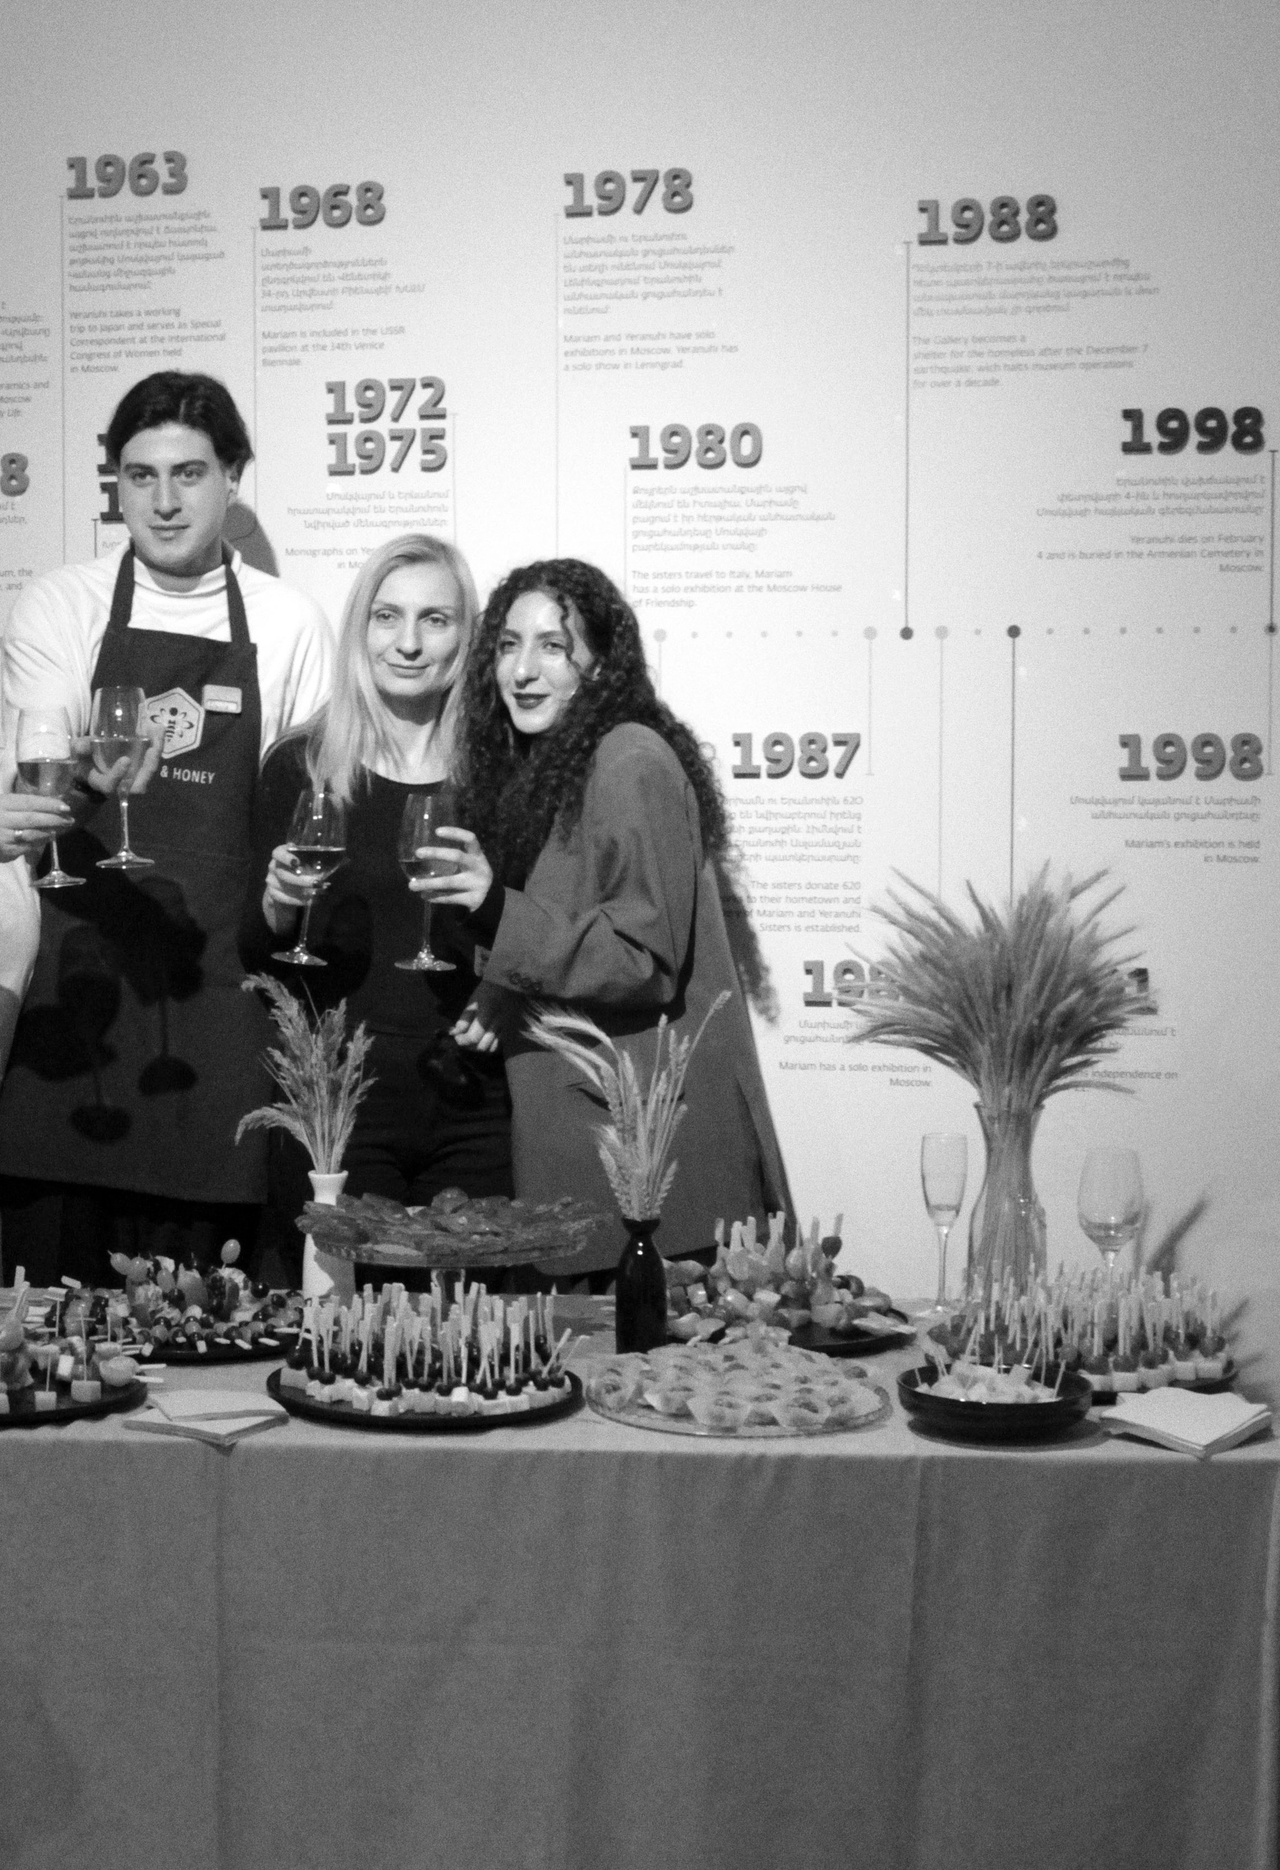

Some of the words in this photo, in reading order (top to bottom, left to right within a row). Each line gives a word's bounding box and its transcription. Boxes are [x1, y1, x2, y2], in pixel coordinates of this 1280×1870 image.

[66, 150, 188, 200] 1963
[563, 167, 694, 218] 1978
[259, 181, 386, 231] 1968
[917, 194, 1058, 246] 1988
[168, 333, 226, 342] International
[125, 350, 159, 358] Women
[325, 376, 447, 425] 1972
[1121, 406, 1265, 455] 1998
[629, 422, 763, 471] 1980
[327, 428, 448, 476] 1975
[1201, 536, 1214, 544] on
[286, 548, 343, 557] Monographs
[1126, 551, 1144, 559] the
[632, 570, 649, 579] The
[652, 571, 682, 579] sisters
[685, 570, 713, 579] travel
[755, 570, 793, 579] Mariam
[633, 584, 649, 594] has
[661, 584, 680, 593] solo
[684, 584, 731, 593] exhibition
[735, 585, 744, 593] at
[748, 584, 763, 593] the
[767, 584, 808, 593] Moscow
[811, 584, 842, 592] House
[732, 732, 861, 779] 1987
[1119, 733, 1264, 781] 1998
[160, 765, 168, 778] &
[172, 767, 215, 784] HONEY
[1174, 839, 1224, 848] exhibition
[1228, 839, 1235, 848] is
[1238, 839, 1260, 848] held
[1204, 855, 1213, 863] in
[751, 881, 768, 889] The
[805, 881, 839, 890] donate
[760, 896, 782, 904] their
[785, 896, 839, 904] hometown
[843, 895, 861, 904] and
[757, 909, 793, 918] Mariam
[797, 909, 815, 918] and
[795, 924, 801, 932] is
[779, 1062, 817, 1070] Mariam
[820, 1062, 836, 1071] has
[849, 1063, 868, 1072] solo
[872, 1064, 920, 1073] exhibition
